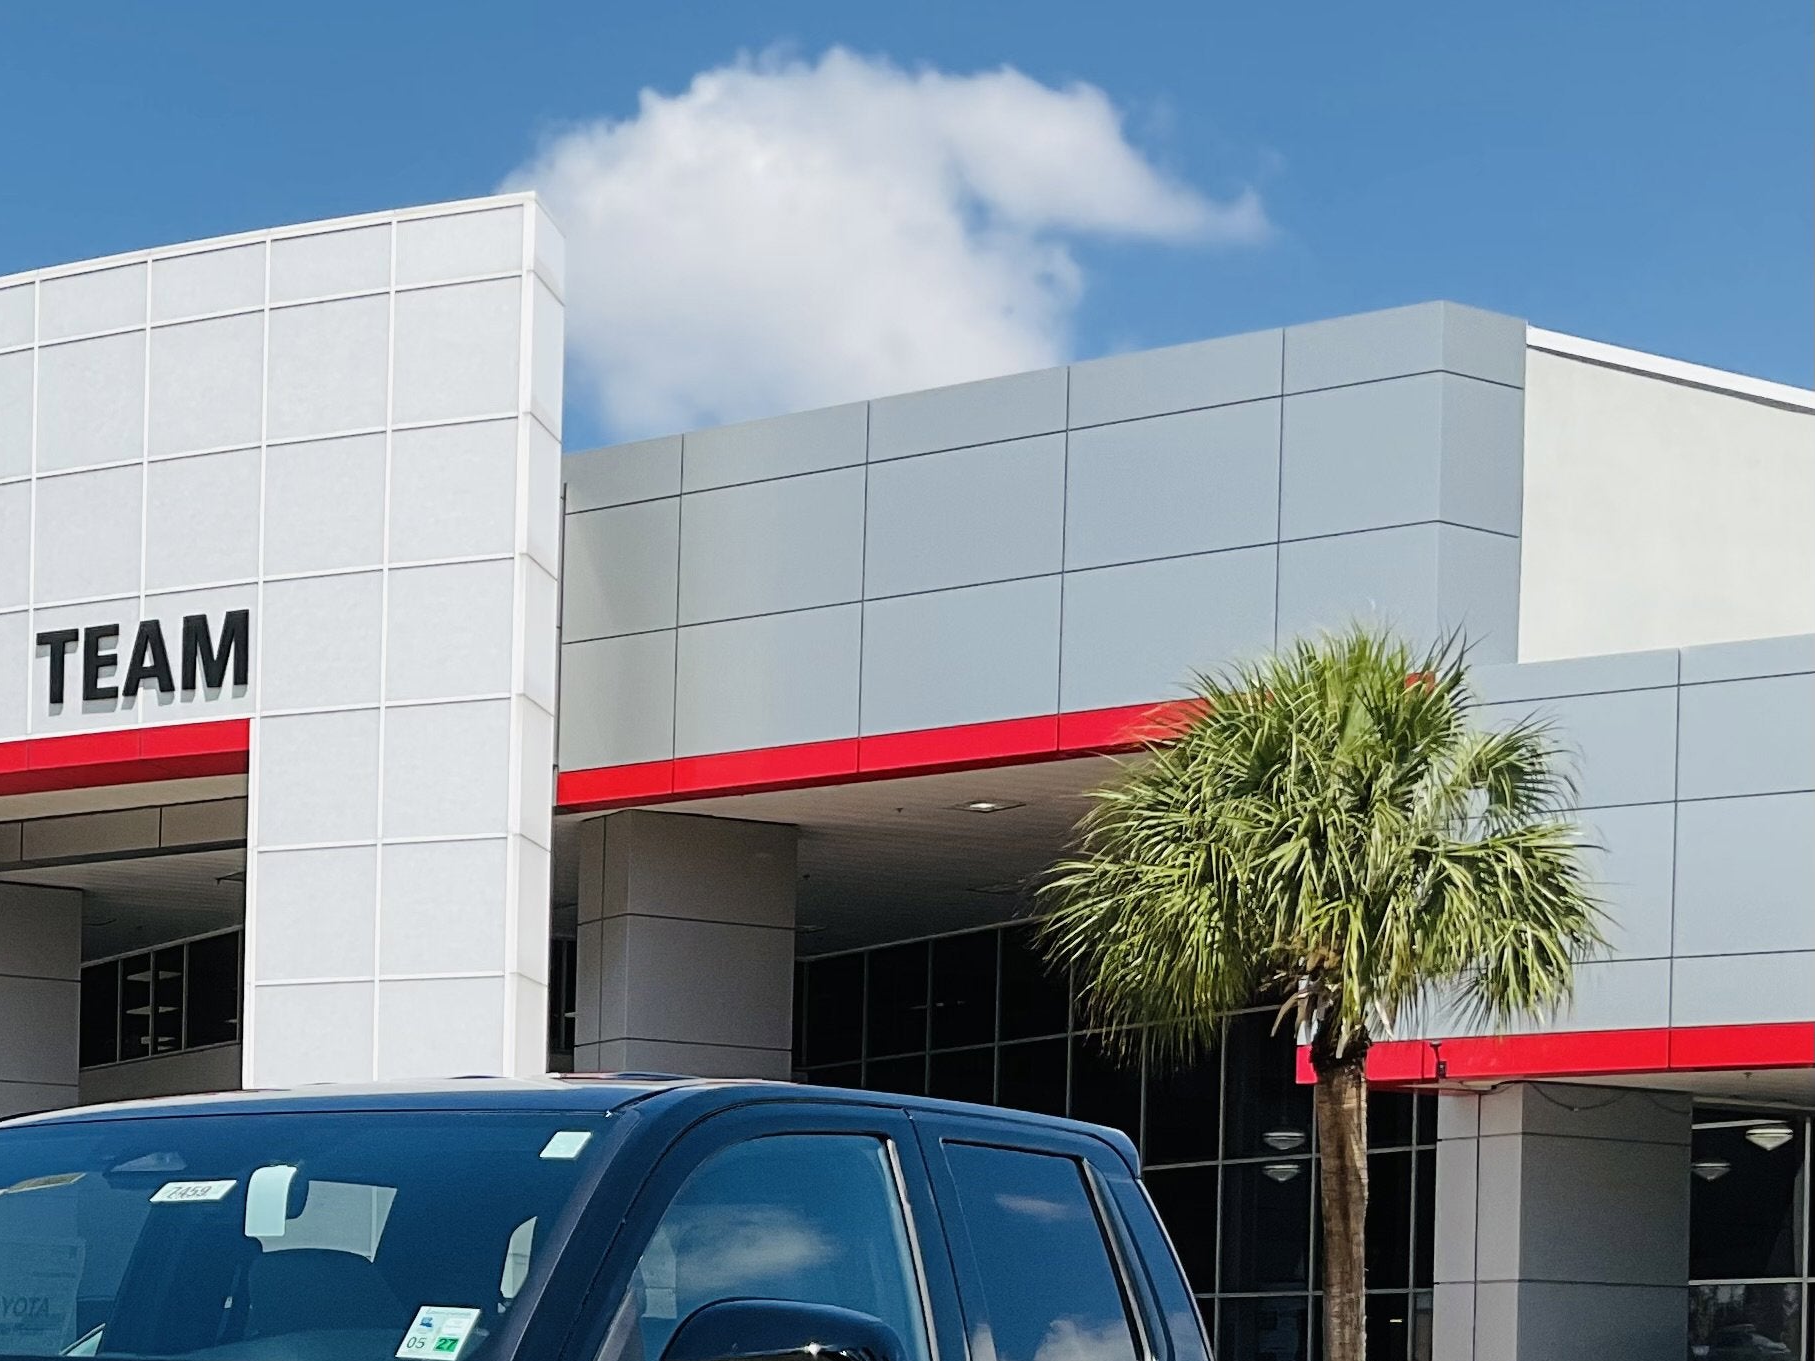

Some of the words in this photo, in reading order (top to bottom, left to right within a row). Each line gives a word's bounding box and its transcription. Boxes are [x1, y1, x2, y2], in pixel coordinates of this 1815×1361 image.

[36, 609, 249, 703] TEAM
[407, 1337, 427, 1349] 05
[435, 1338, 459, 1350] 27
